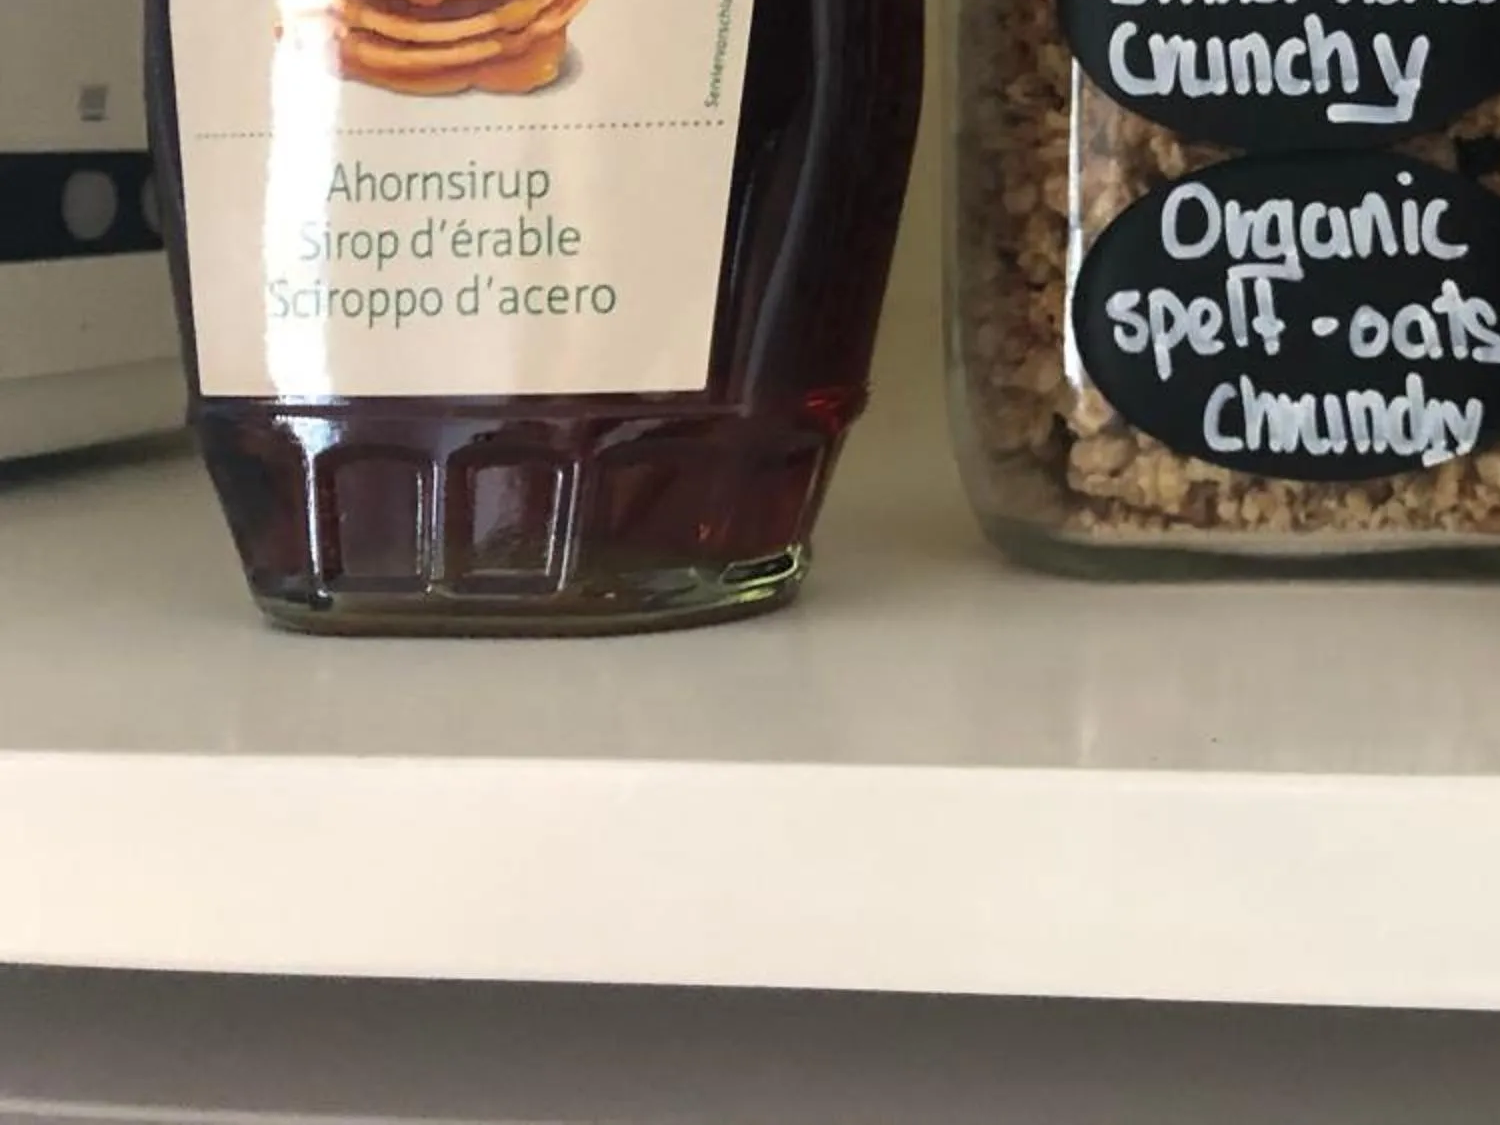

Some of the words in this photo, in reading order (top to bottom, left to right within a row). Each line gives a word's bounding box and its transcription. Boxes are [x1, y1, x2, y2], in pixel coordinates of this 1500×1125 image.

[1108, 13, 1430, 124] Crunchy
[327, 160, 551, 211] Ahornsirup
[299, 220, 399, 271] Sirop
[1161, 171, 1469, 281] Organic
[268, 277, 443, 330] Sciroppo
[456, 274, 617, 316] d'acero
